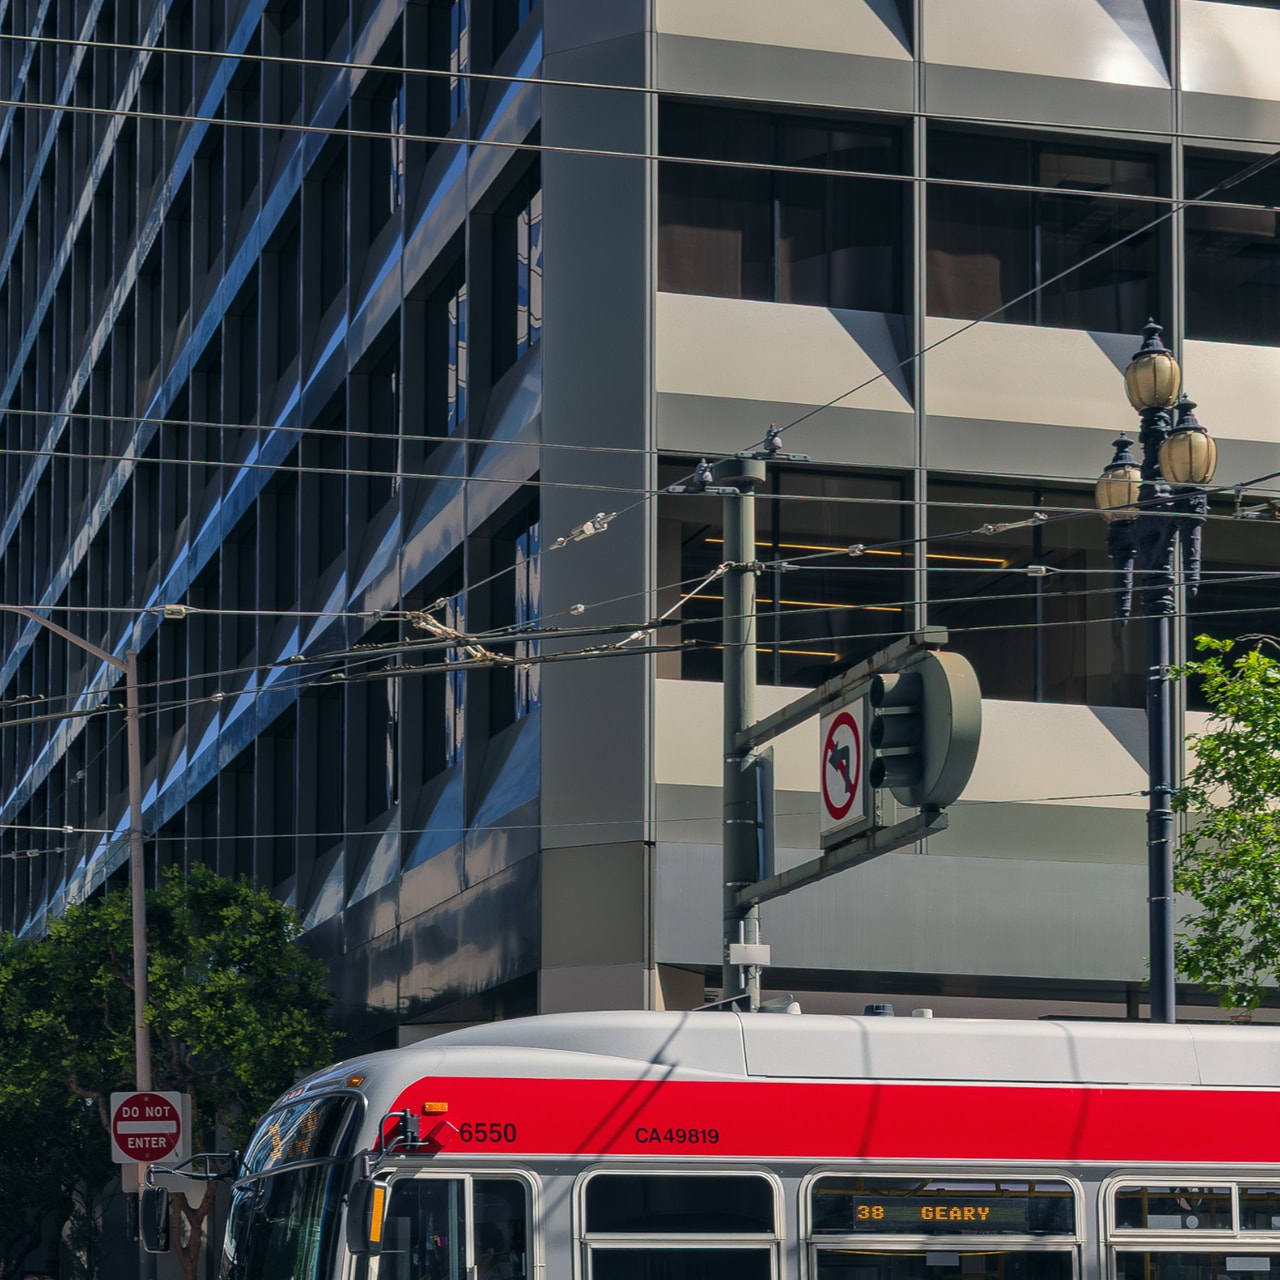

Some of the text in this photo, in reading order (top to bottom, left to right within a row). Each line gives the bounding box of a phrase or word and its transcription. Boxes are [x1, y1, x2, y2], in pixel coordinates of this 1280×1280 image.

[122, 1106, 171, 1118] DO NOT
[459, 1122, 518, 1144] 6550
[634, 1127, 720, 1145] CA49819
[127, 1137, 167, 1149] ENTER
[856, 1204, 990, 1221] 38 GEARY
